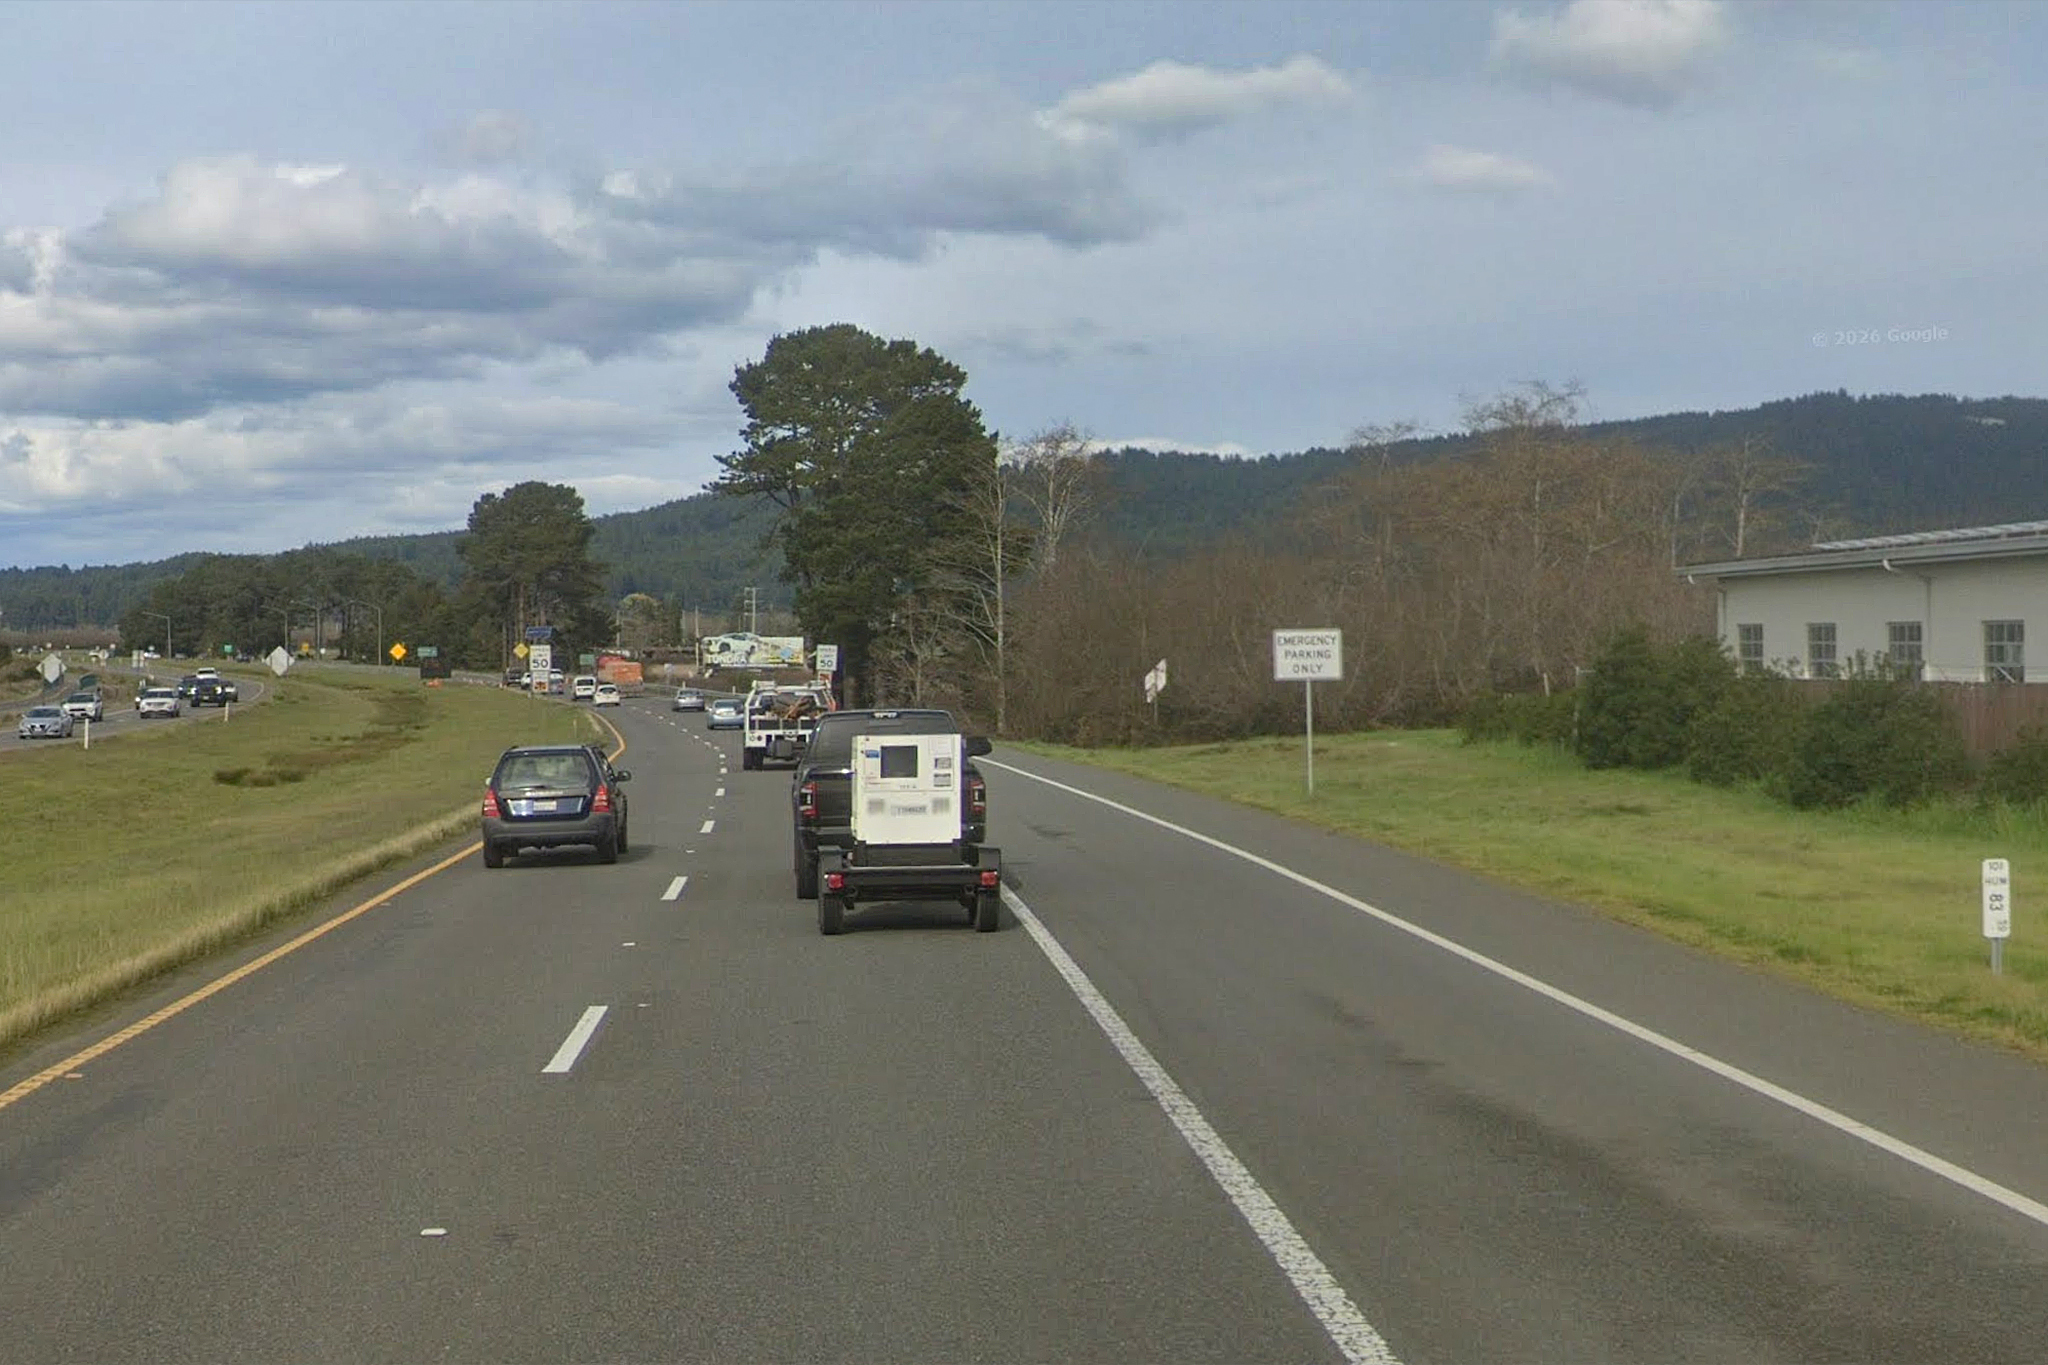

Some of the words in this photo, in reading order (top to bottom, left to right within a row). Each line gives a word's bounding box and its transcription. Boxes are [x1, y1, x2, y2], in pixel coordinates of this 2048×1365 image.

[1277, 634, 1337, 646] EMERGENCY
[1284, 648, 1332, 659] PARKING
[532, 658, 549, 669] 50
[820, 659, 834, 668] 50
[1292, 663, 1323, 674] ONLY
[1989, 893, 2005, 911] 83
